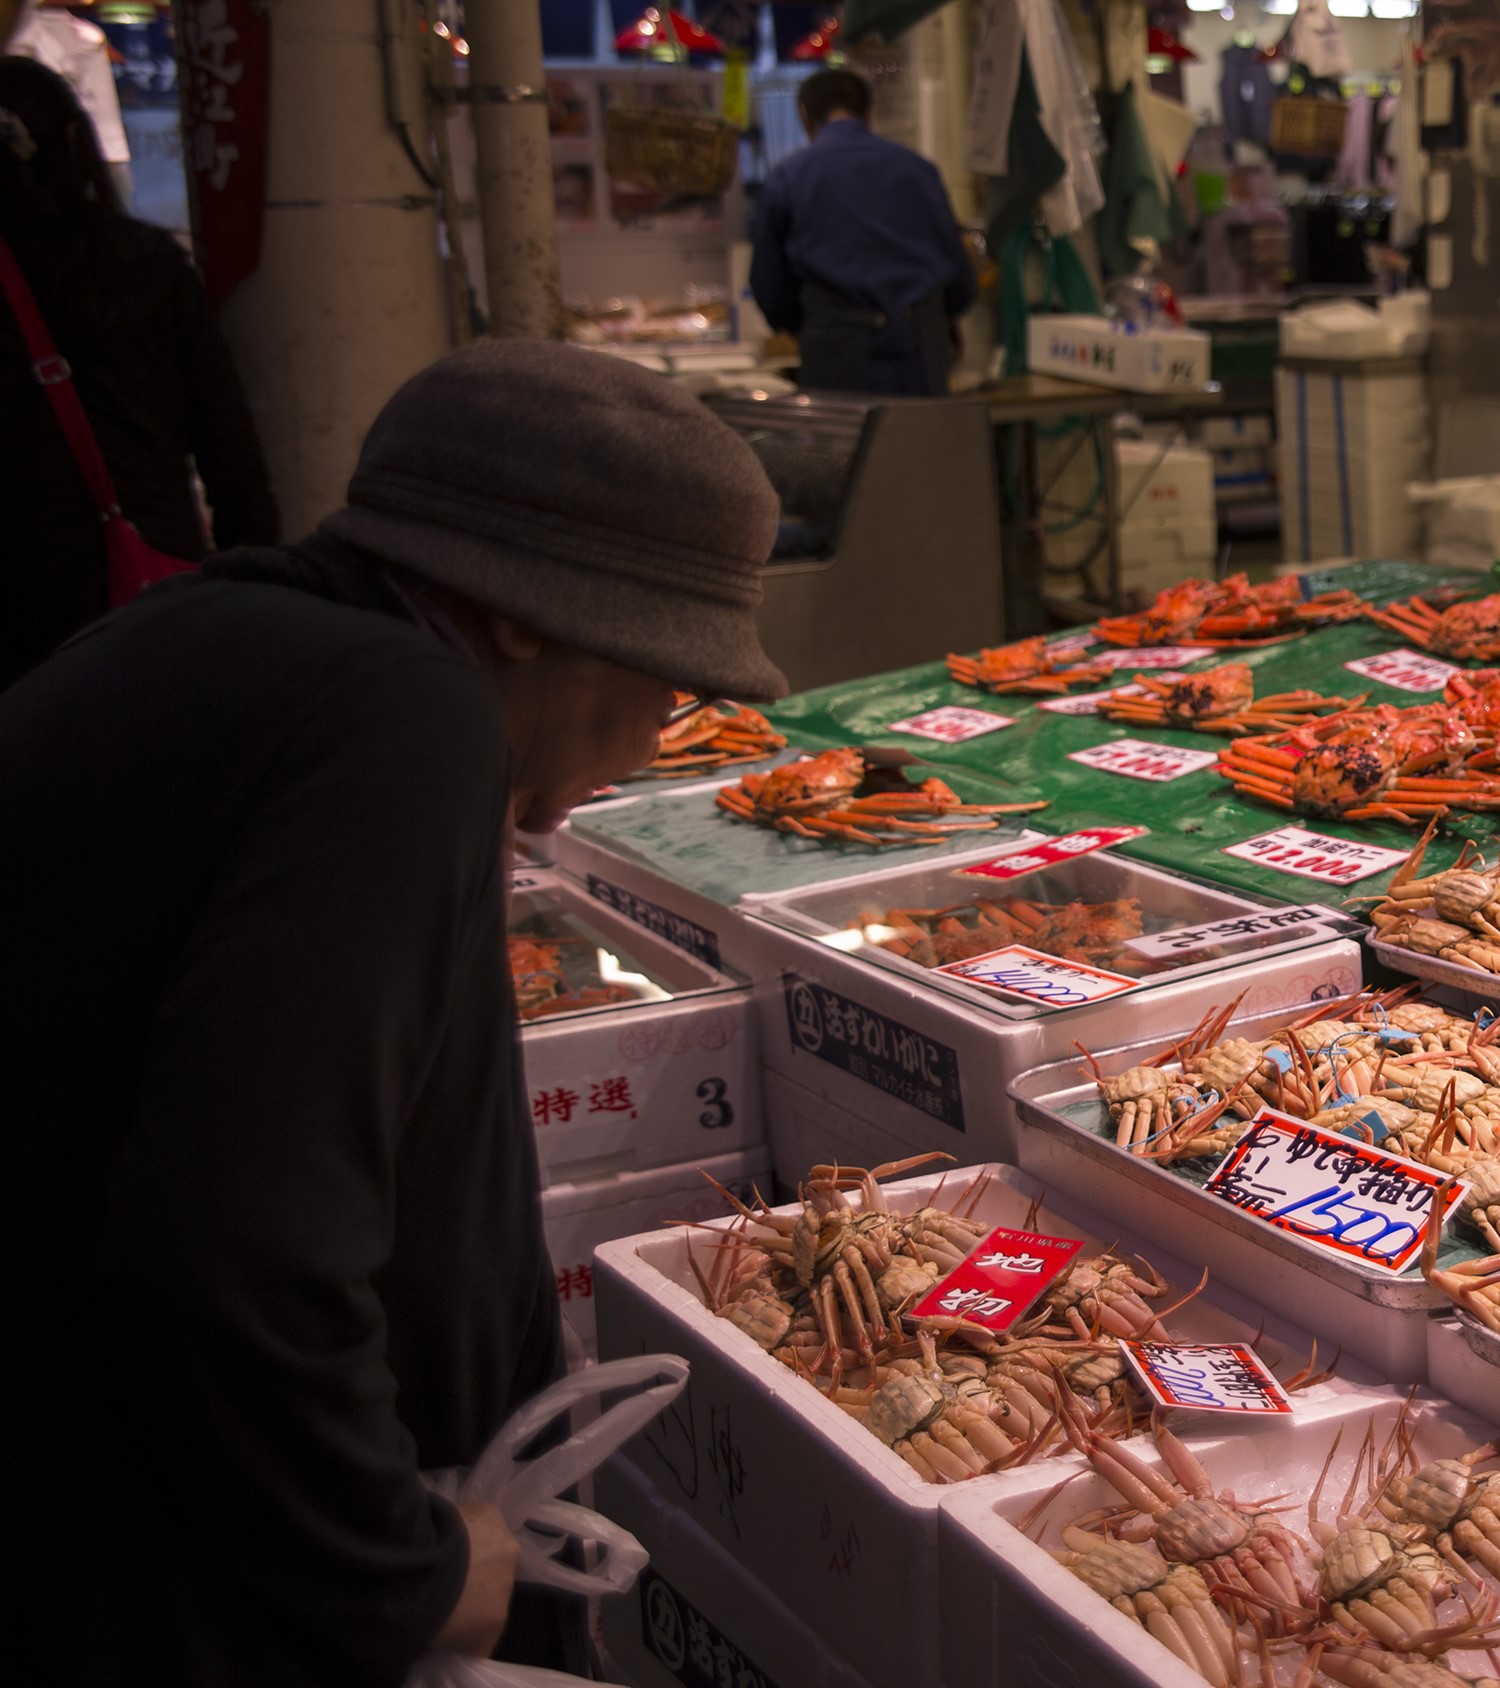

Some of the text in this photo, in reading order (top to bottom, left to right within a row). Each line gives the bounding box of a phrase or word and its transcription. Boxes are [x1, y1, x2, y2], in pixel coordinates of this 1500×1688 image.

[696, 1077, 735, 1130] 3
[1265, 1185, 1419, 1266] 1500
[938, 1252, 1047, 1317] 地物
[1149, 1363, 1226, 1408] 2000
